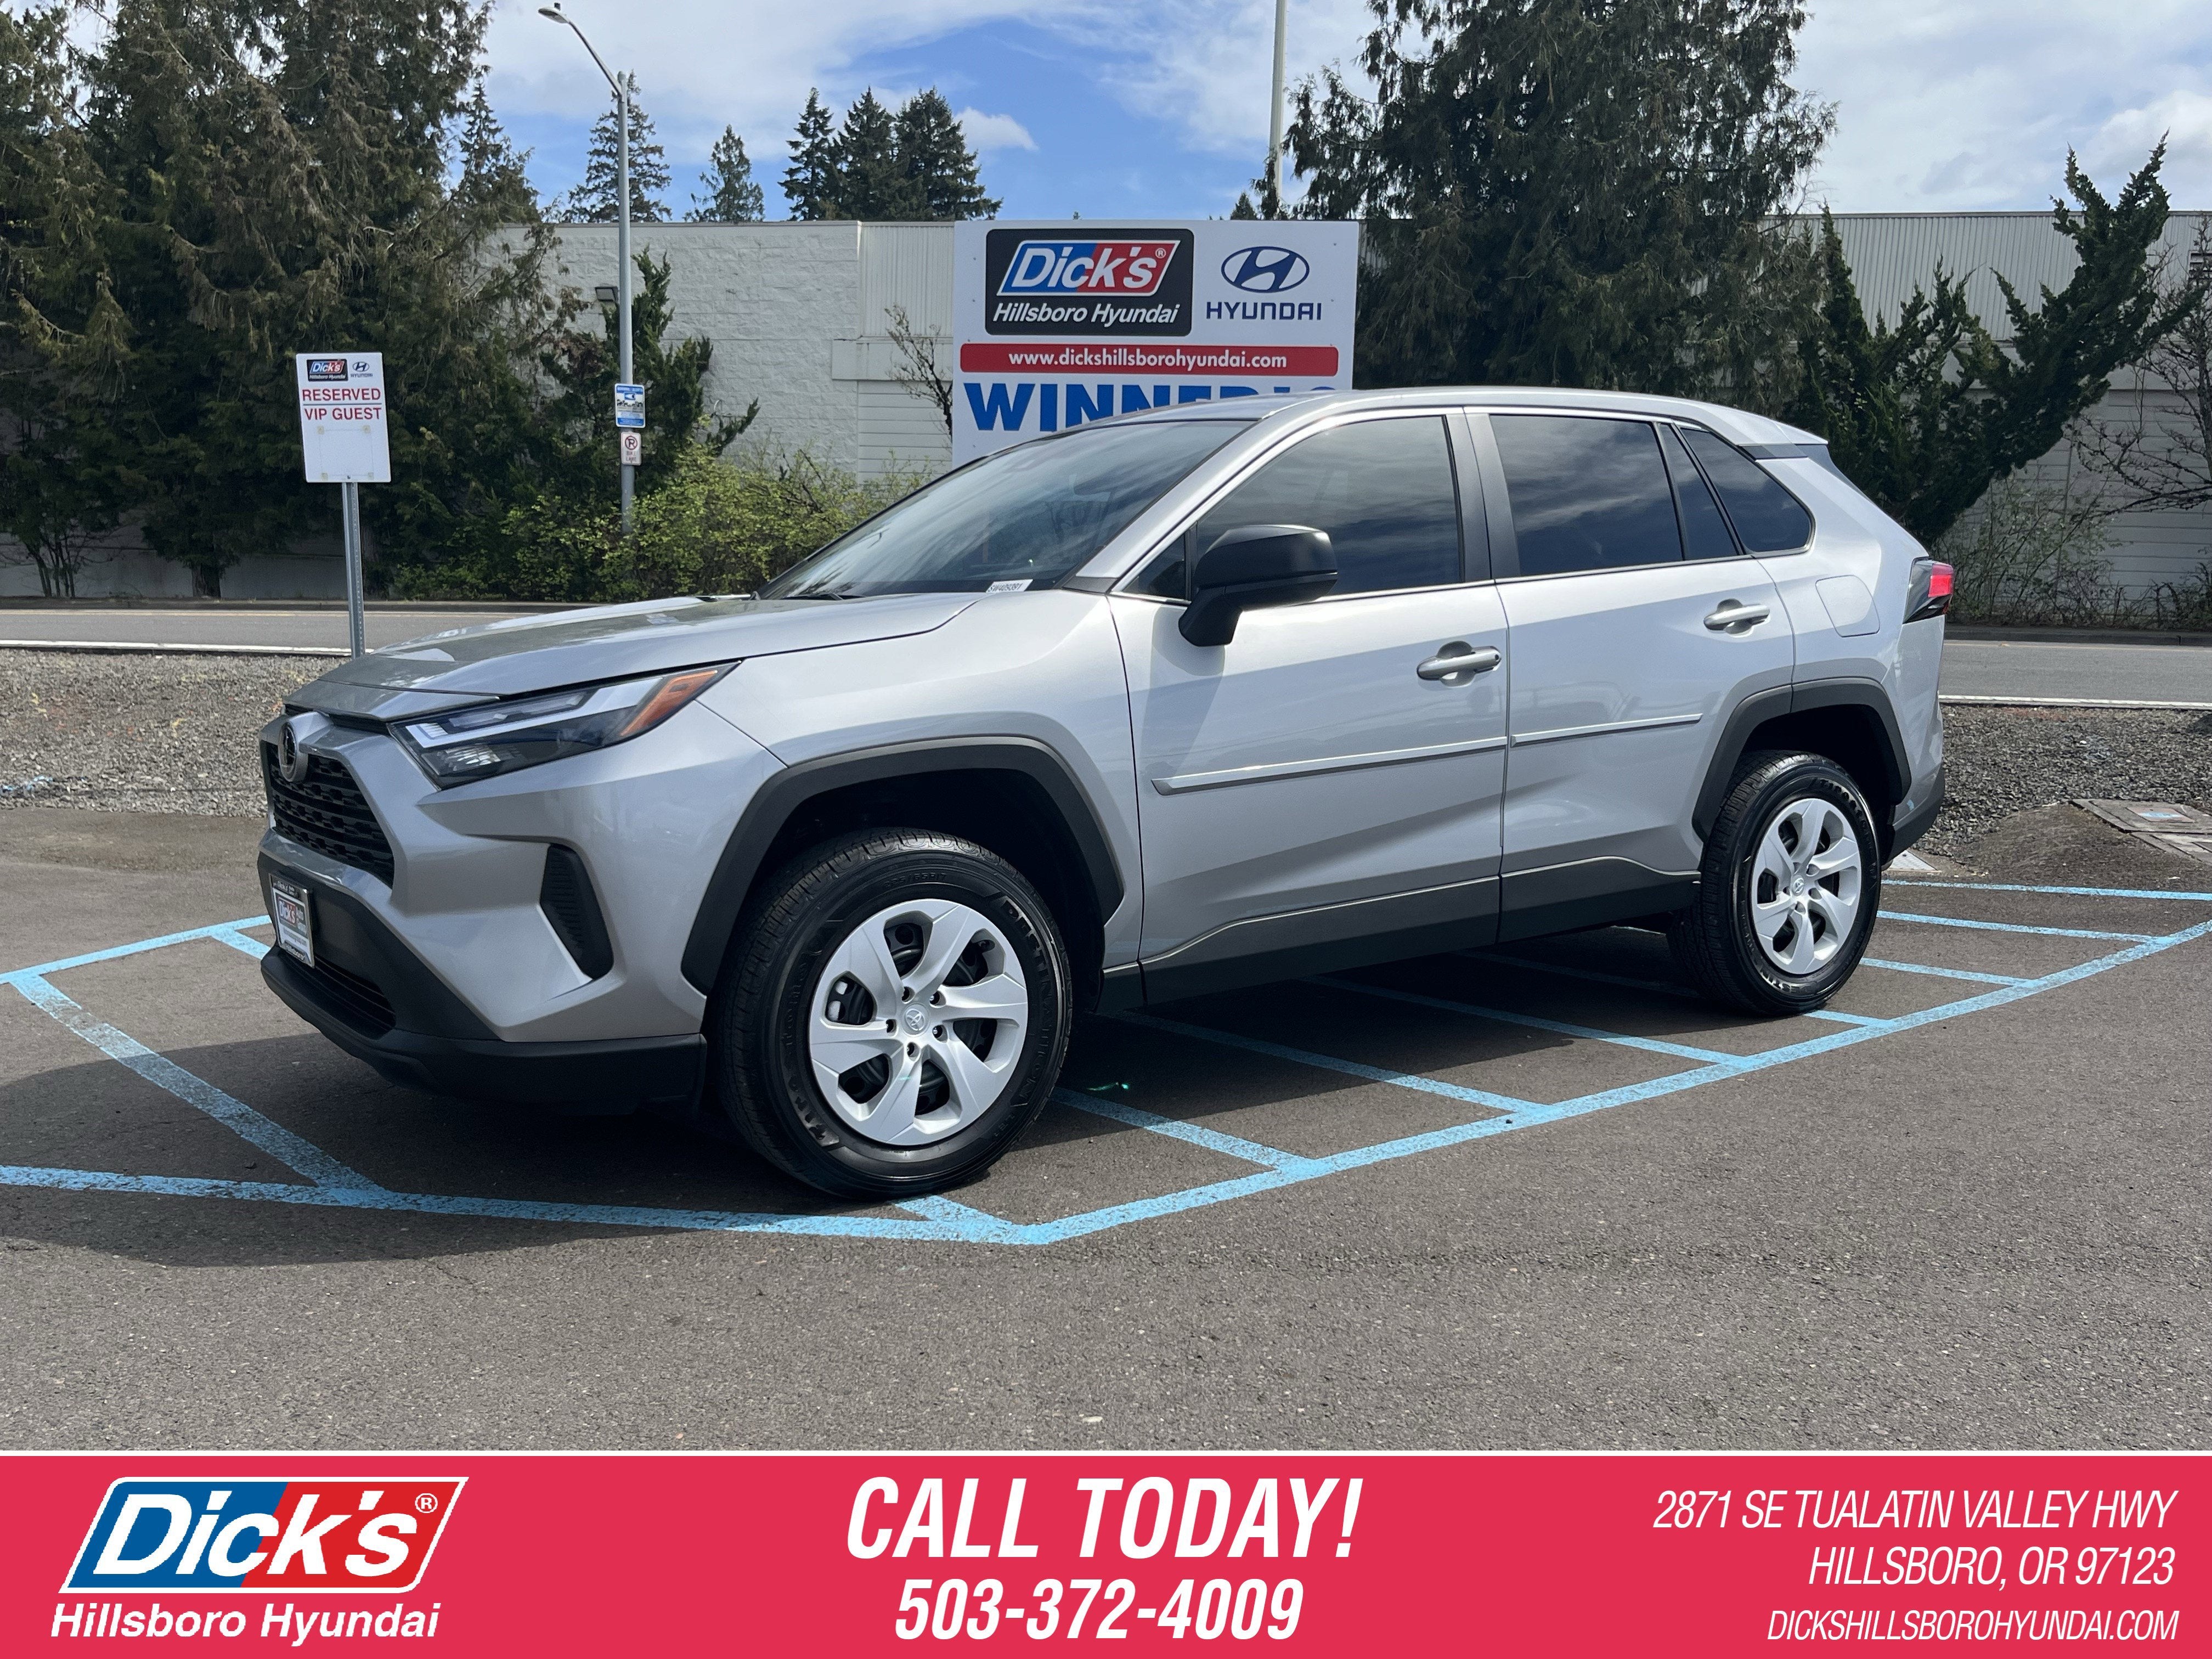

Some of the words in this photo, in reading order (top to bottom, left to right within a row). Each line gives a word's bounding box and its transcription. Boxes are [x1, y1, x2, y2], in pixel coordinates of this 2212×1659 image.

[993, 303, 1087, 323] Hillsboro
[1091, 304, 1180, 328] Hyundai
[1207, 301, 1322, 321] HYUNDAI
[1008, 348, 1287, 372] www.dickshillsborohyundai.com
[302, 388, 381, 402] RESERVED
[304, 408, 328, 420] VIP
[332, 407, 382, 420] GUEST
